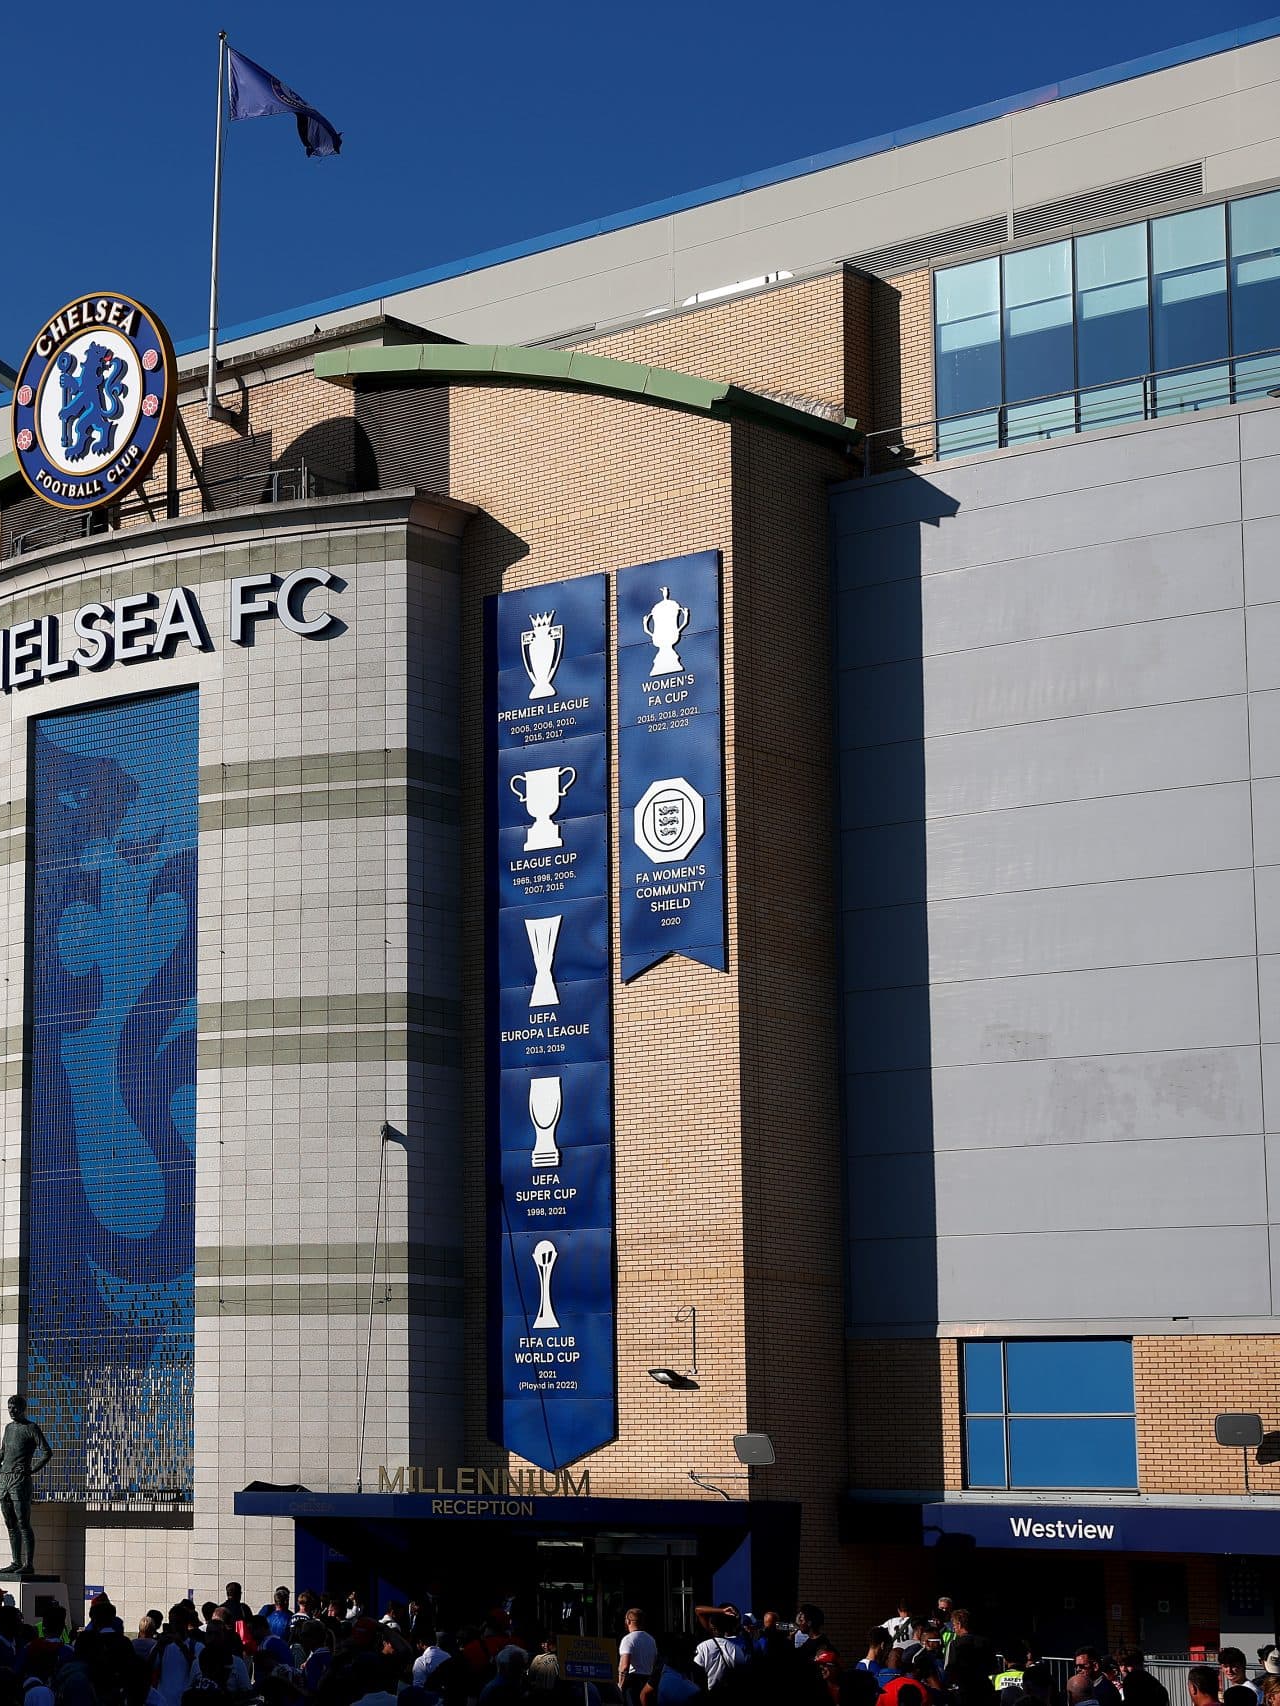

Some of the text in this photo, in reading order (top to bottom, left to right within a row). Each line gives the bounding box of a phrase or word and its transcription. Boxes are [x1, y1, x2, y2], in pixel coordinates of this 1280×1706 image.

[35, 300, 137, 358] CHELSEA
[35, 443, 140, 498] FOOTBALL CLUB
[230, 567, 333, 643] FC
[641, 674, 695, 693] WOMEN'S
[648, 690, 689, 707] FA CUP
[498, 697, 589, 722] PREMIER LEAGUE
[637, 714, 657, 724] 2015,
[658, 710, 679, 720] 2018,
[510, 725, 532, 735] 2005,
[556, 717, 577, 727] 2010,
[648, 718, 689, 733] 2022, 2023
[524, 730, 563, 743] 2015, 2017
[510, 852, 577, 871] LEAGUE CUP
[554, 870, 577, 880] 2005,
[636, 864, 706, 884] FA WOMEN'S
[524, 882, 564, 895] 2007, 2015
[636, 880, 705, 899] COMMUNITY
[650, 897, 691, 912] SHIELD
[661, 917, 681, 926] 2020
[529, 1012, 557, 1024] UEFA
[501, 1024, 590, 1042] EUROPA LEAGUE
[525, 1044, 565, 1055] 2013, 2019
[532, 1174, 560, 1186] UEFA
[516, 1188, 577, 1202] SUPER CUP
[527, 1207, 566, 1217] 1998, 2021
[519, 1336, 575, 1348] FIFA CLUB
[514, 1351, 580, 1363] WORLD CUP
[538, 1370, 557, 1378] 2021
[547, 1381, 555, 1389] in
[556, 1381, 578, 1391] 2022)
[378, 1465, 590, 1496] MILLENNIUM
[431, 1499, 533, 1516] RECEPTION
[1009, 1517, 1115, 1540] Westview
